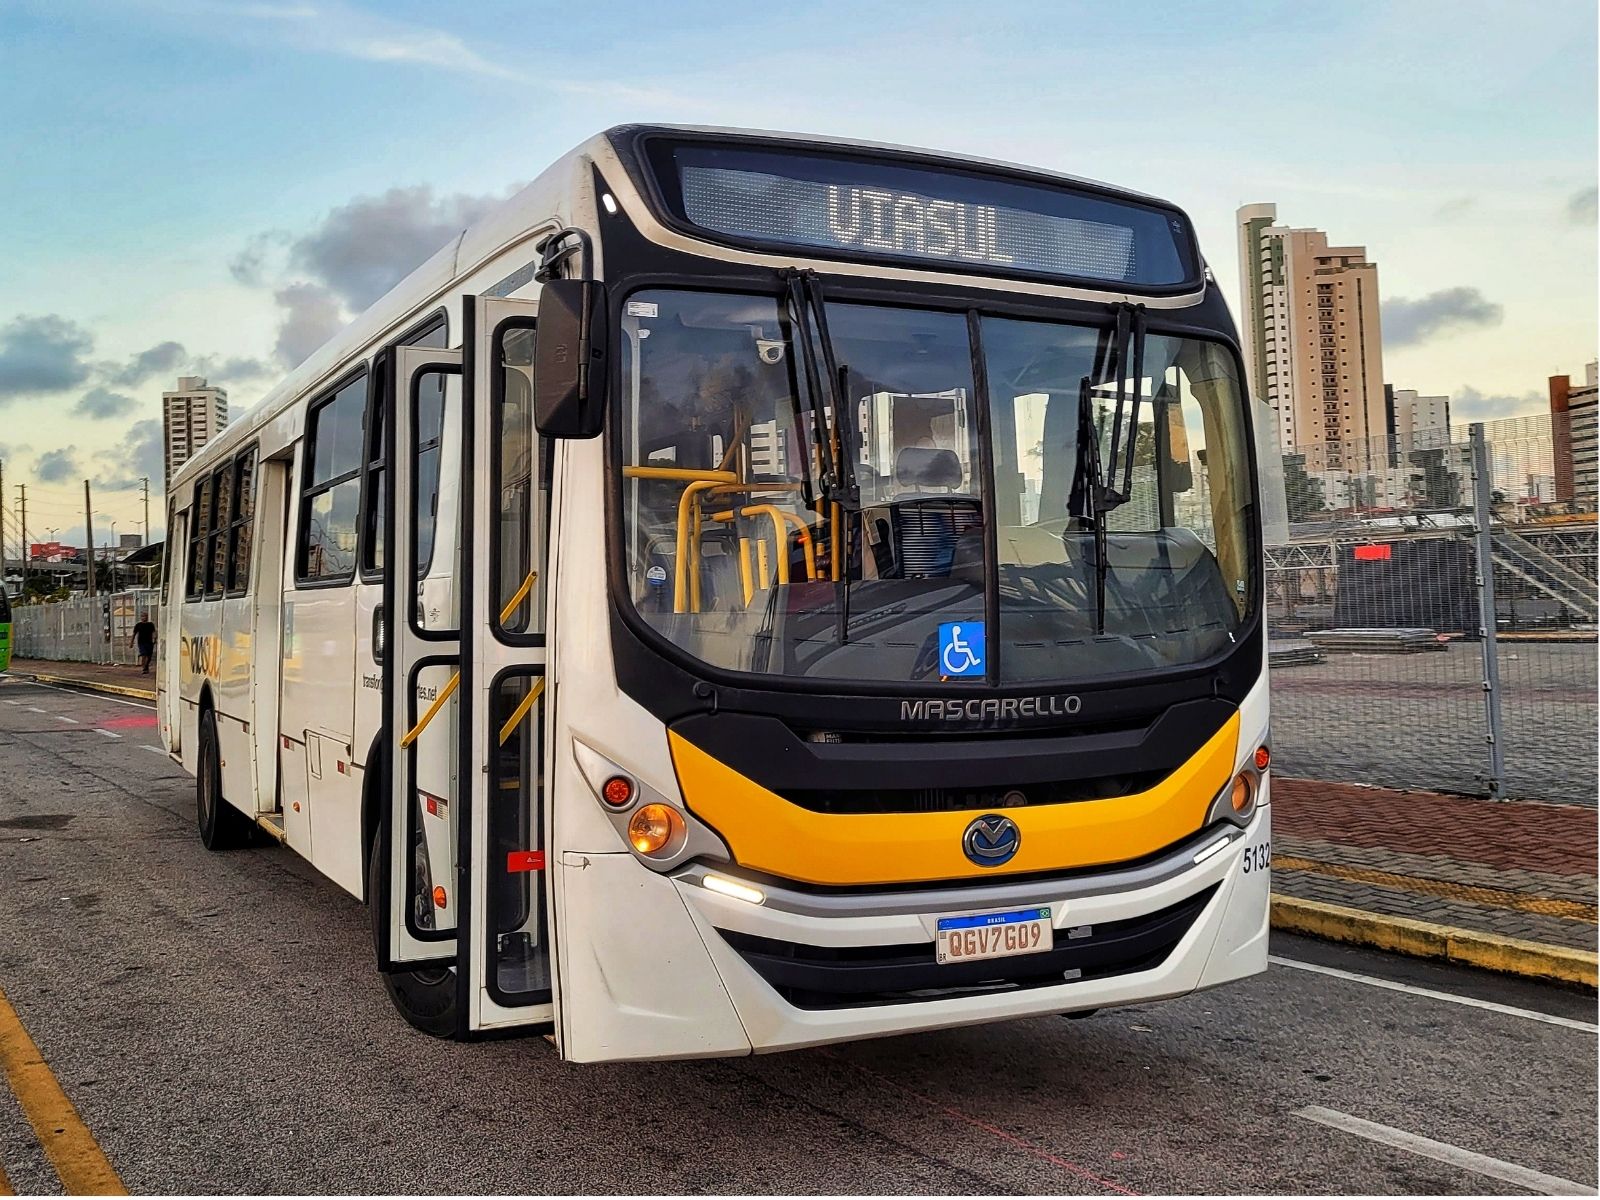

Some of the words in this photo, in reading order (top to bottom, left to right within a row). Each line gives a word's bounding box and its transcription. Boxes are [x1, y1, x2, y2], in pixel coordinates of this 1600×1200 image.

[829, 185, 1013, 262] VIASUL
[900, 695, 1082, 721] MASCARELLO
[1243, 841, 1270, 874] 5132
[949, 923, 1041, 957] QGV7G09
